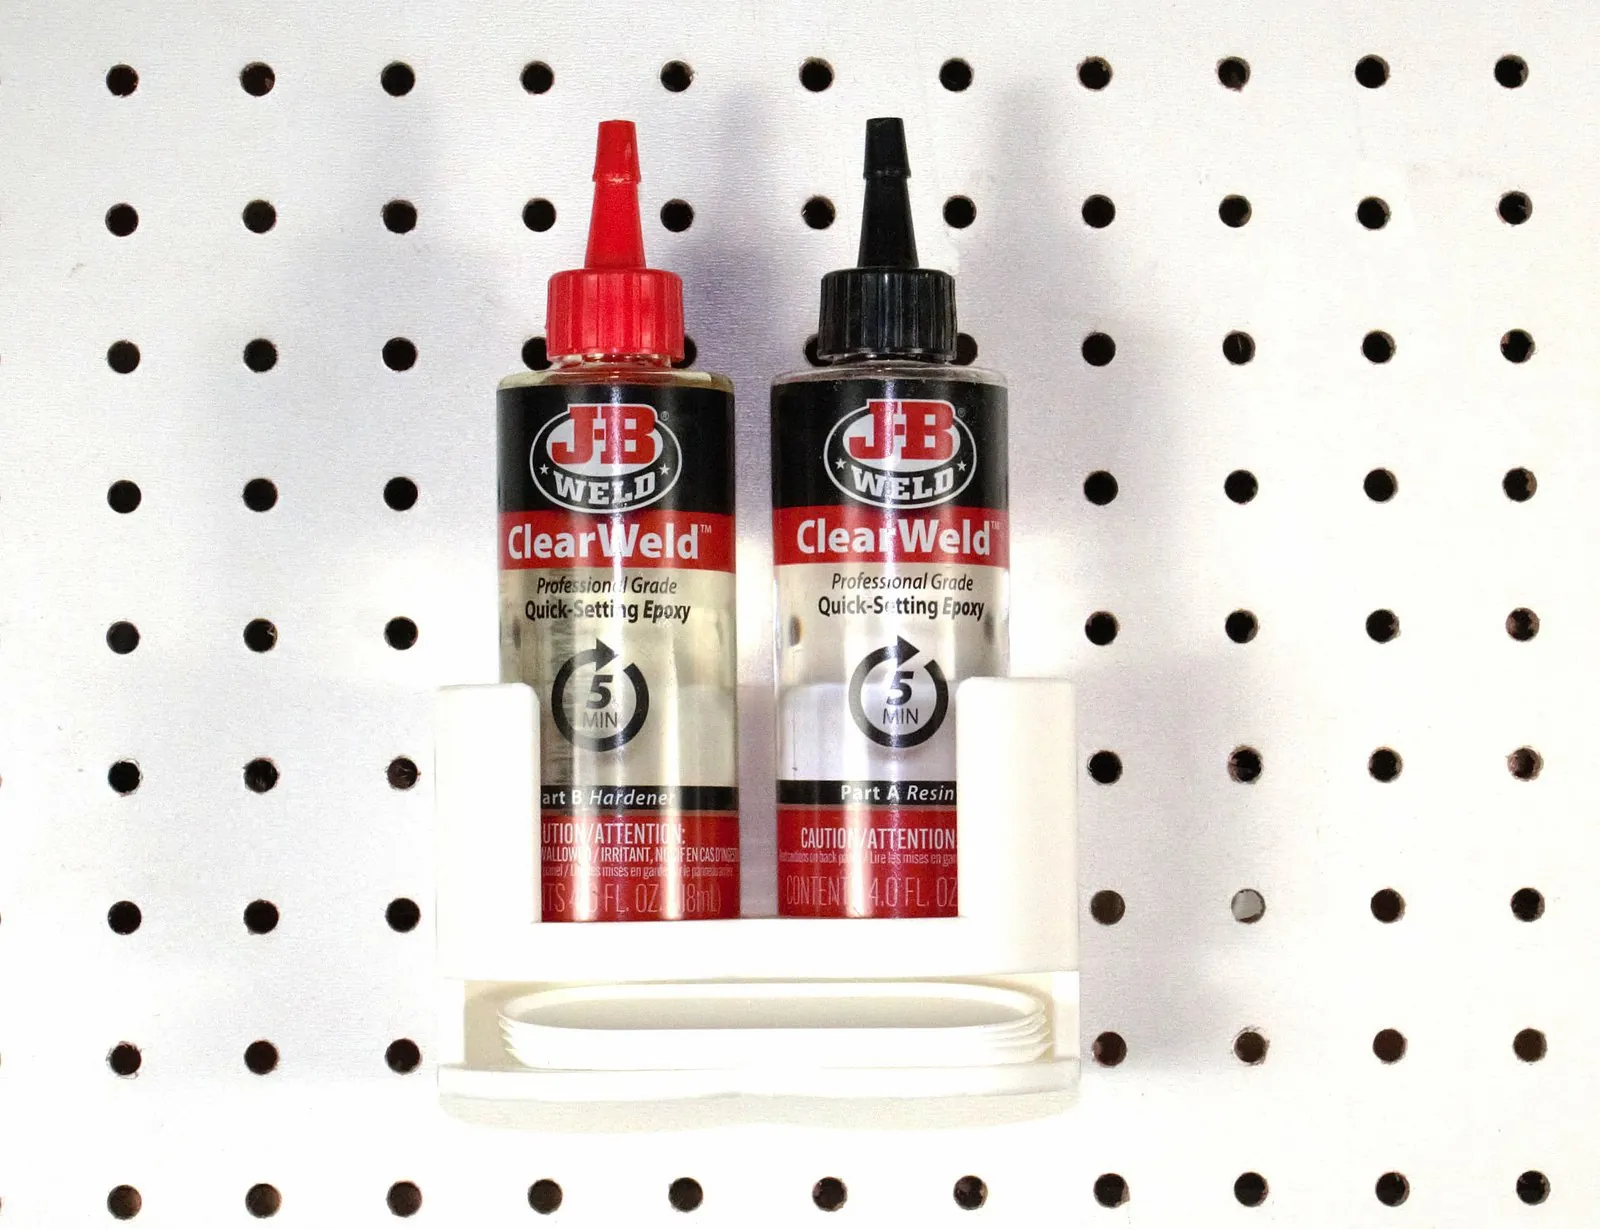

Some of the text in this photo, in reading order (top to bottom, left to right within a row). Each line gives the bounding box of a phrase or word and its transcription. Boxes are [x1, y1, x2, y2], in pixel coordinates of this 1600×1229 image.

[553, 471, 656, 505] WELD
[851, 465, 955, 500] WELD
[631, 577, 677, 594] Grade
[832, 572, 973, 591] Professional Grade
[643, 601, 691, 624] Epoxy
[942, 597, 984, 622] Epoxy
[585, 674, 614, 710] 5
[886, 671, 914, 706] 5
[582, 712, 618, 729] MIN
[882, 708, 919, 725] MIN
[542, 788, 676, 806] art B Hardener
[841, 785, 954, 801] Part A Resin
[542, 822, 686, 845] UTION/ATTENTION:
[601, 847, 654, 865] IRRITANT,
[686, 847, 698, 862] EN
[700, 847, 715, 862] CAS
[903, 852, 930, 864] mises
[930, 853, 942, 864] en
[602, 865, 629, 877] mises
[630, 867, 642, 877] en
[604, 883, 630, 913] FL.
[786, 875, 851, 906] CONTENT
[869, 877, 898, 908] 4.0
[905, 877, 930, 907] FL.
